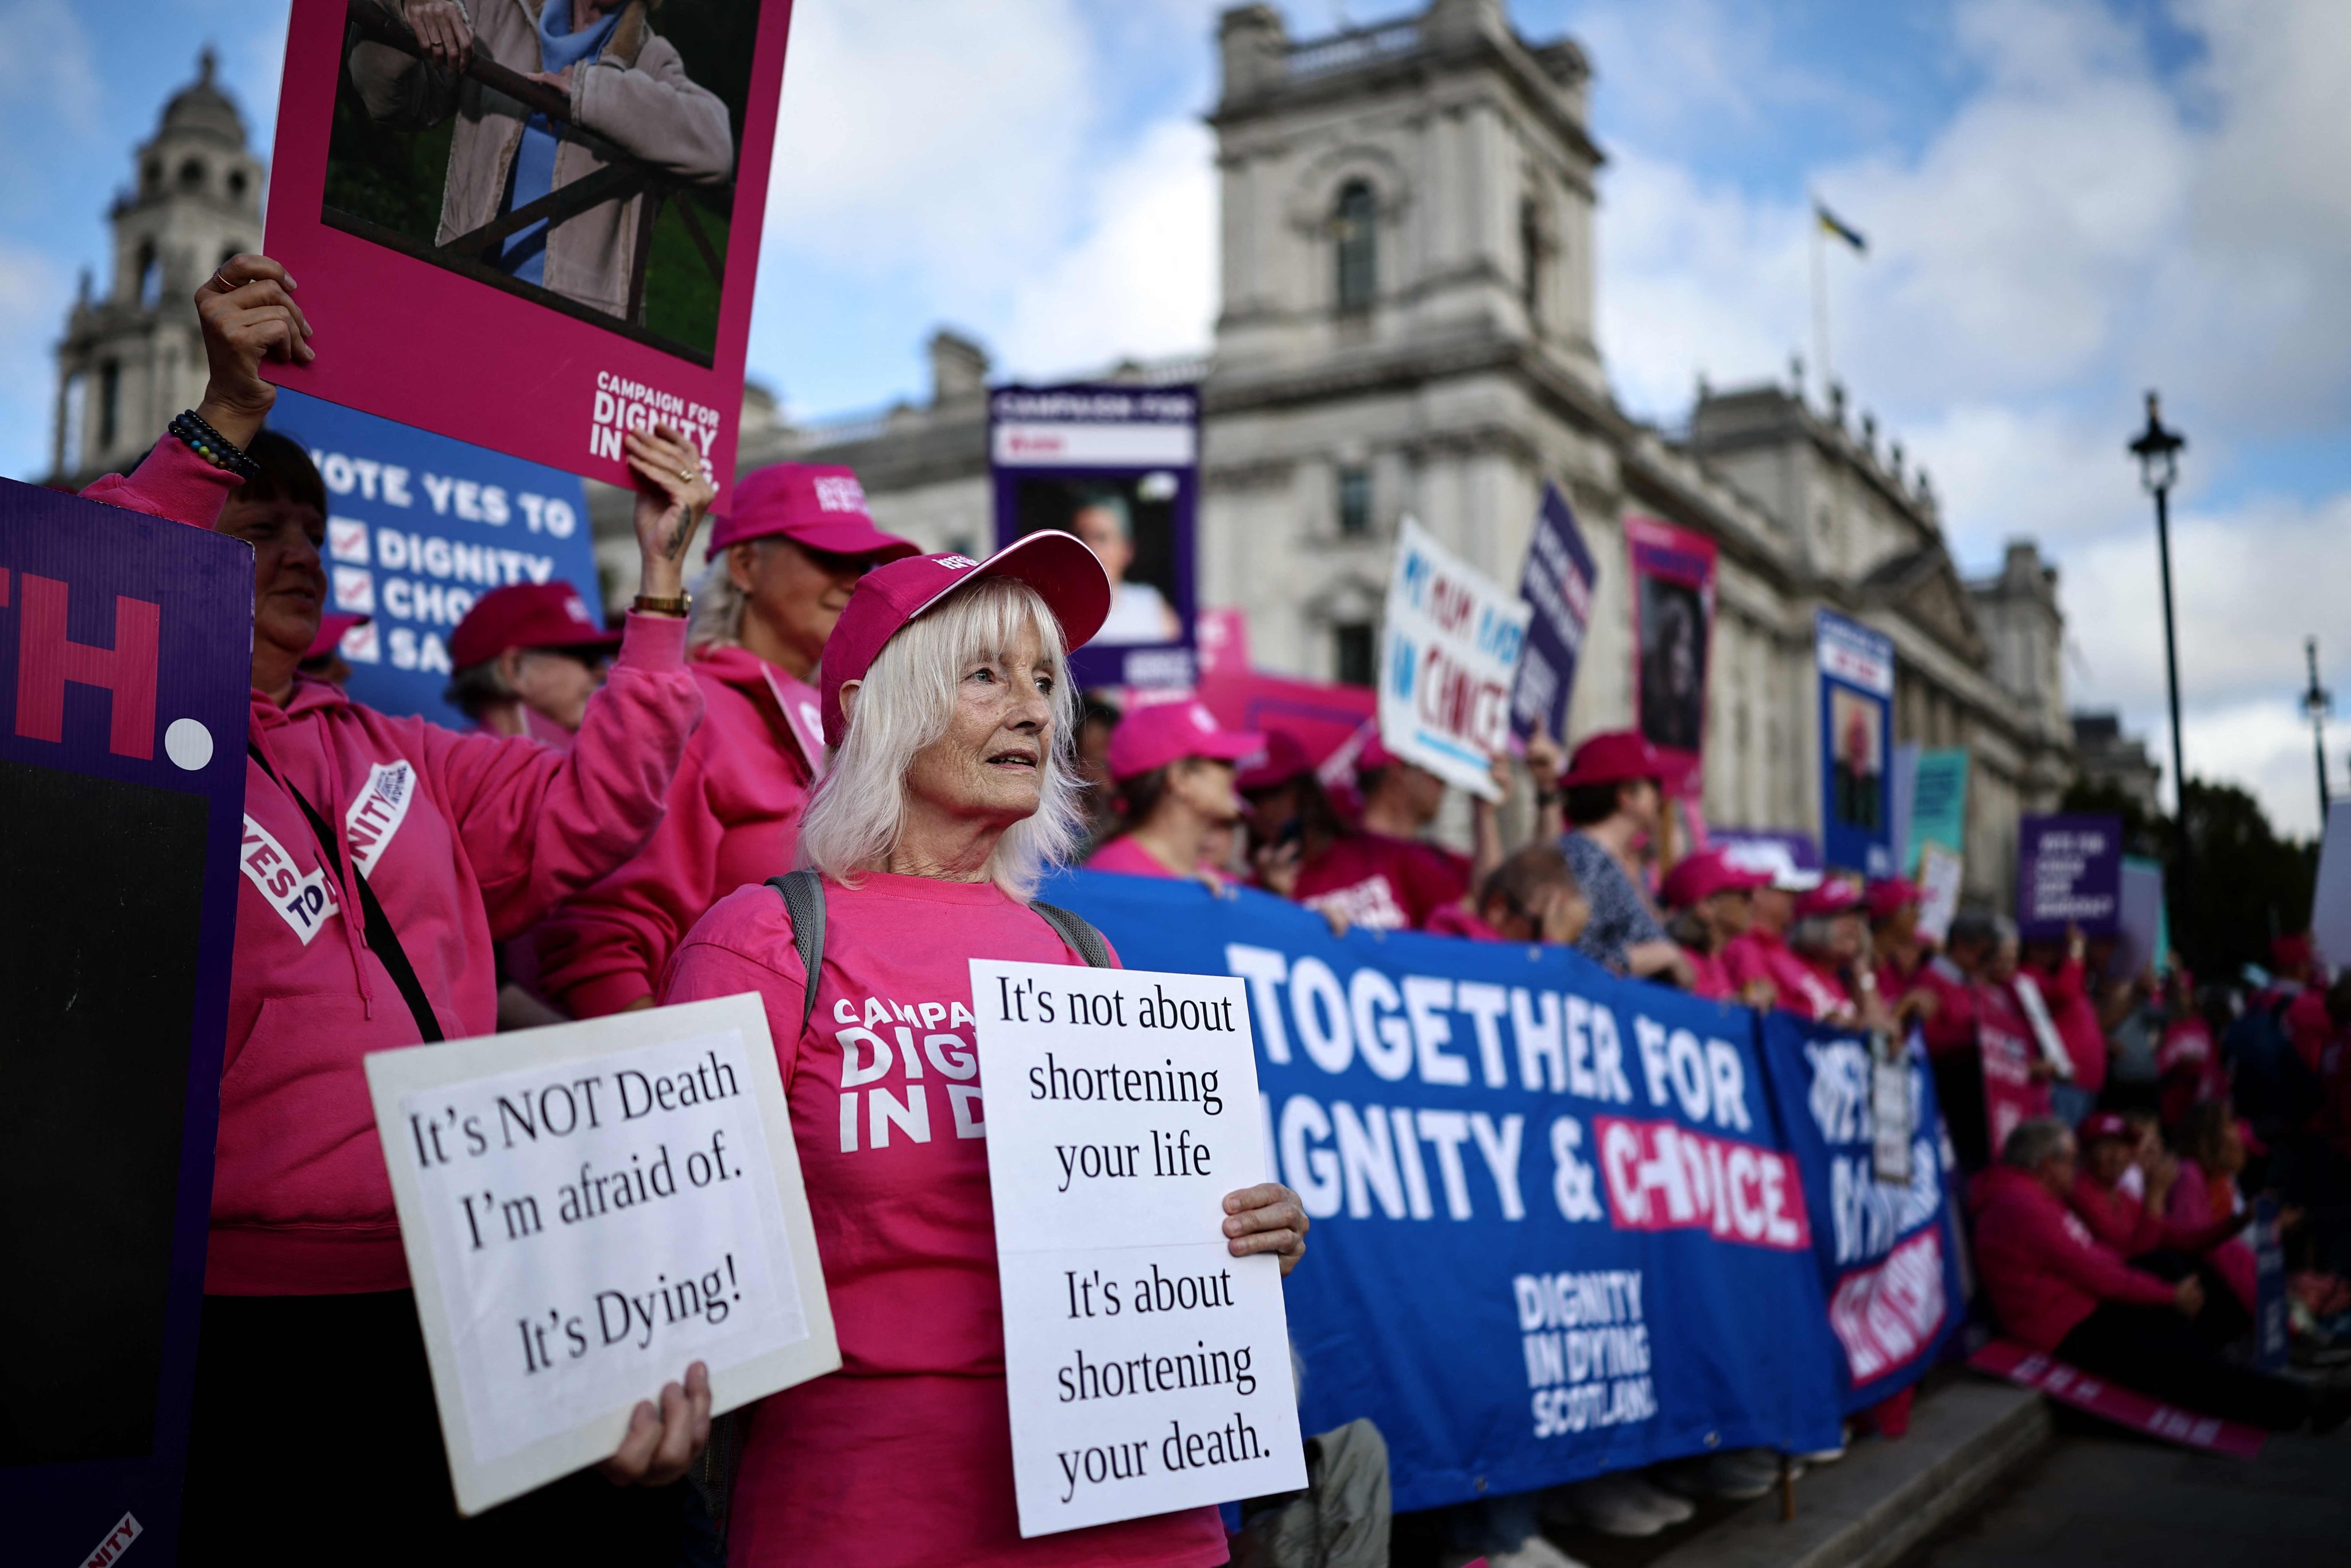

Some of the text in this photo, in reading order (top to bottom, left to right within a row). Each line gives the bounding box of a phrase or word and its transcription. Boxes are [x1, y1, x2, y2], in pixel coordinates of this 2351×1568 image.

[598, 371, 721, 428] CAMPAIGN FOR
[590, 423, 622, 462] IN
[422, 471, 510, 527] YES
[517, 492, 576, 539] TO
[377, 526, 553, 586] DIGNITY
[383, 576, 478, 626] CHO
[389, 627, 454, 675] SA
[286, 885, 324, 928] TO
[834, 997, 975, 1031] CAMPA
[998, 977, 1235, 1032] It's not about
[835, 1027, 978, 1088] DIG
[1225, 943, 1634, 1105] TOGETHER
[1633, 1014, 1751, 1132] FOR
[497, 1077, 604, 1148] NOT
[615, 1051, 740, 1120] Death
[1029, 1052, 1223, 1116] shortening
[840, 1084, 987, 1153] IN D
[560, 1145, 676, 1224] afraid
[687, 1130, 742, 1187] of.
[1055, 1129, 1211, 1193] your life
[1551, 1116, 1603, 1222] &
[595, 1253, 741, 1349] Dying!
[1066, 1264, 1234, 1319] It's about
[1513, 1269, 1643, 1331] DIGNITY
[1058, 1340, 1256, 1403] shortening
[1523, 1323, 1651, 1388] IN DYING
[1057, 1412, 1271, 1504] your death.
[88, 1517, 134, 1568] NITY
